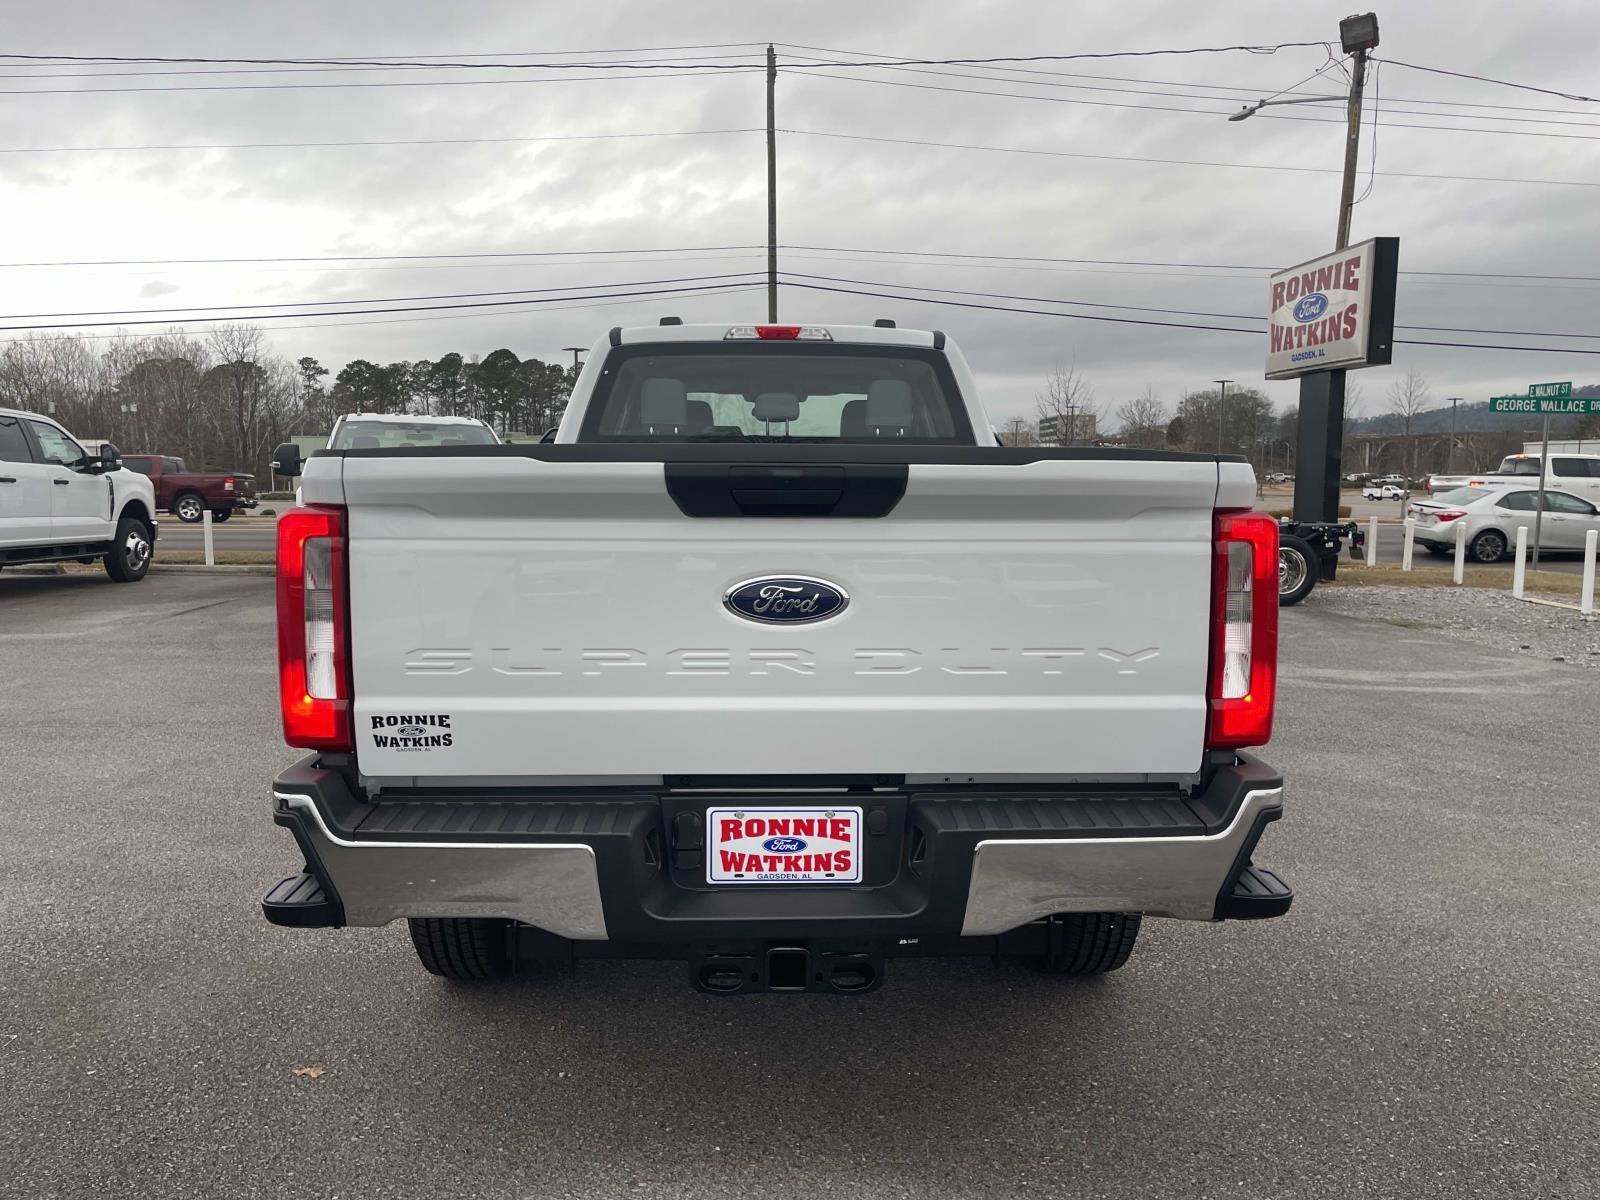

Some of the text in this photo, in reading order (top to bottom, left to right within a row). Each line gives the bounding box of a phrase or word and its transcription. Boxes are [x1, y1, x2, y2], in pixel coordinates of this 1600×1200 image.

[1272, 256, 1361, 314] RONNIE
[1299, 297, 1322, 318] Ford
[1271, 303, 1358, 353] WATKINS
[1529, 384, 1569, 397] E WALNUT ST
[1496, 399, 1536, 411] GEORGE
[1540, 400, 1585, 412] WALLACE
[753, 585, 820, 613] Ford
[405, 647, 1160, 676] SUPER DUTY
[371, 715, 451, 729] RONNIE
[373, 733, 453, 748] WATKINS
[720, 818, 851, 843] RONNIE
[771, 838, 799, 851] Ford
[720, 849, 852, 873] WATKINS
